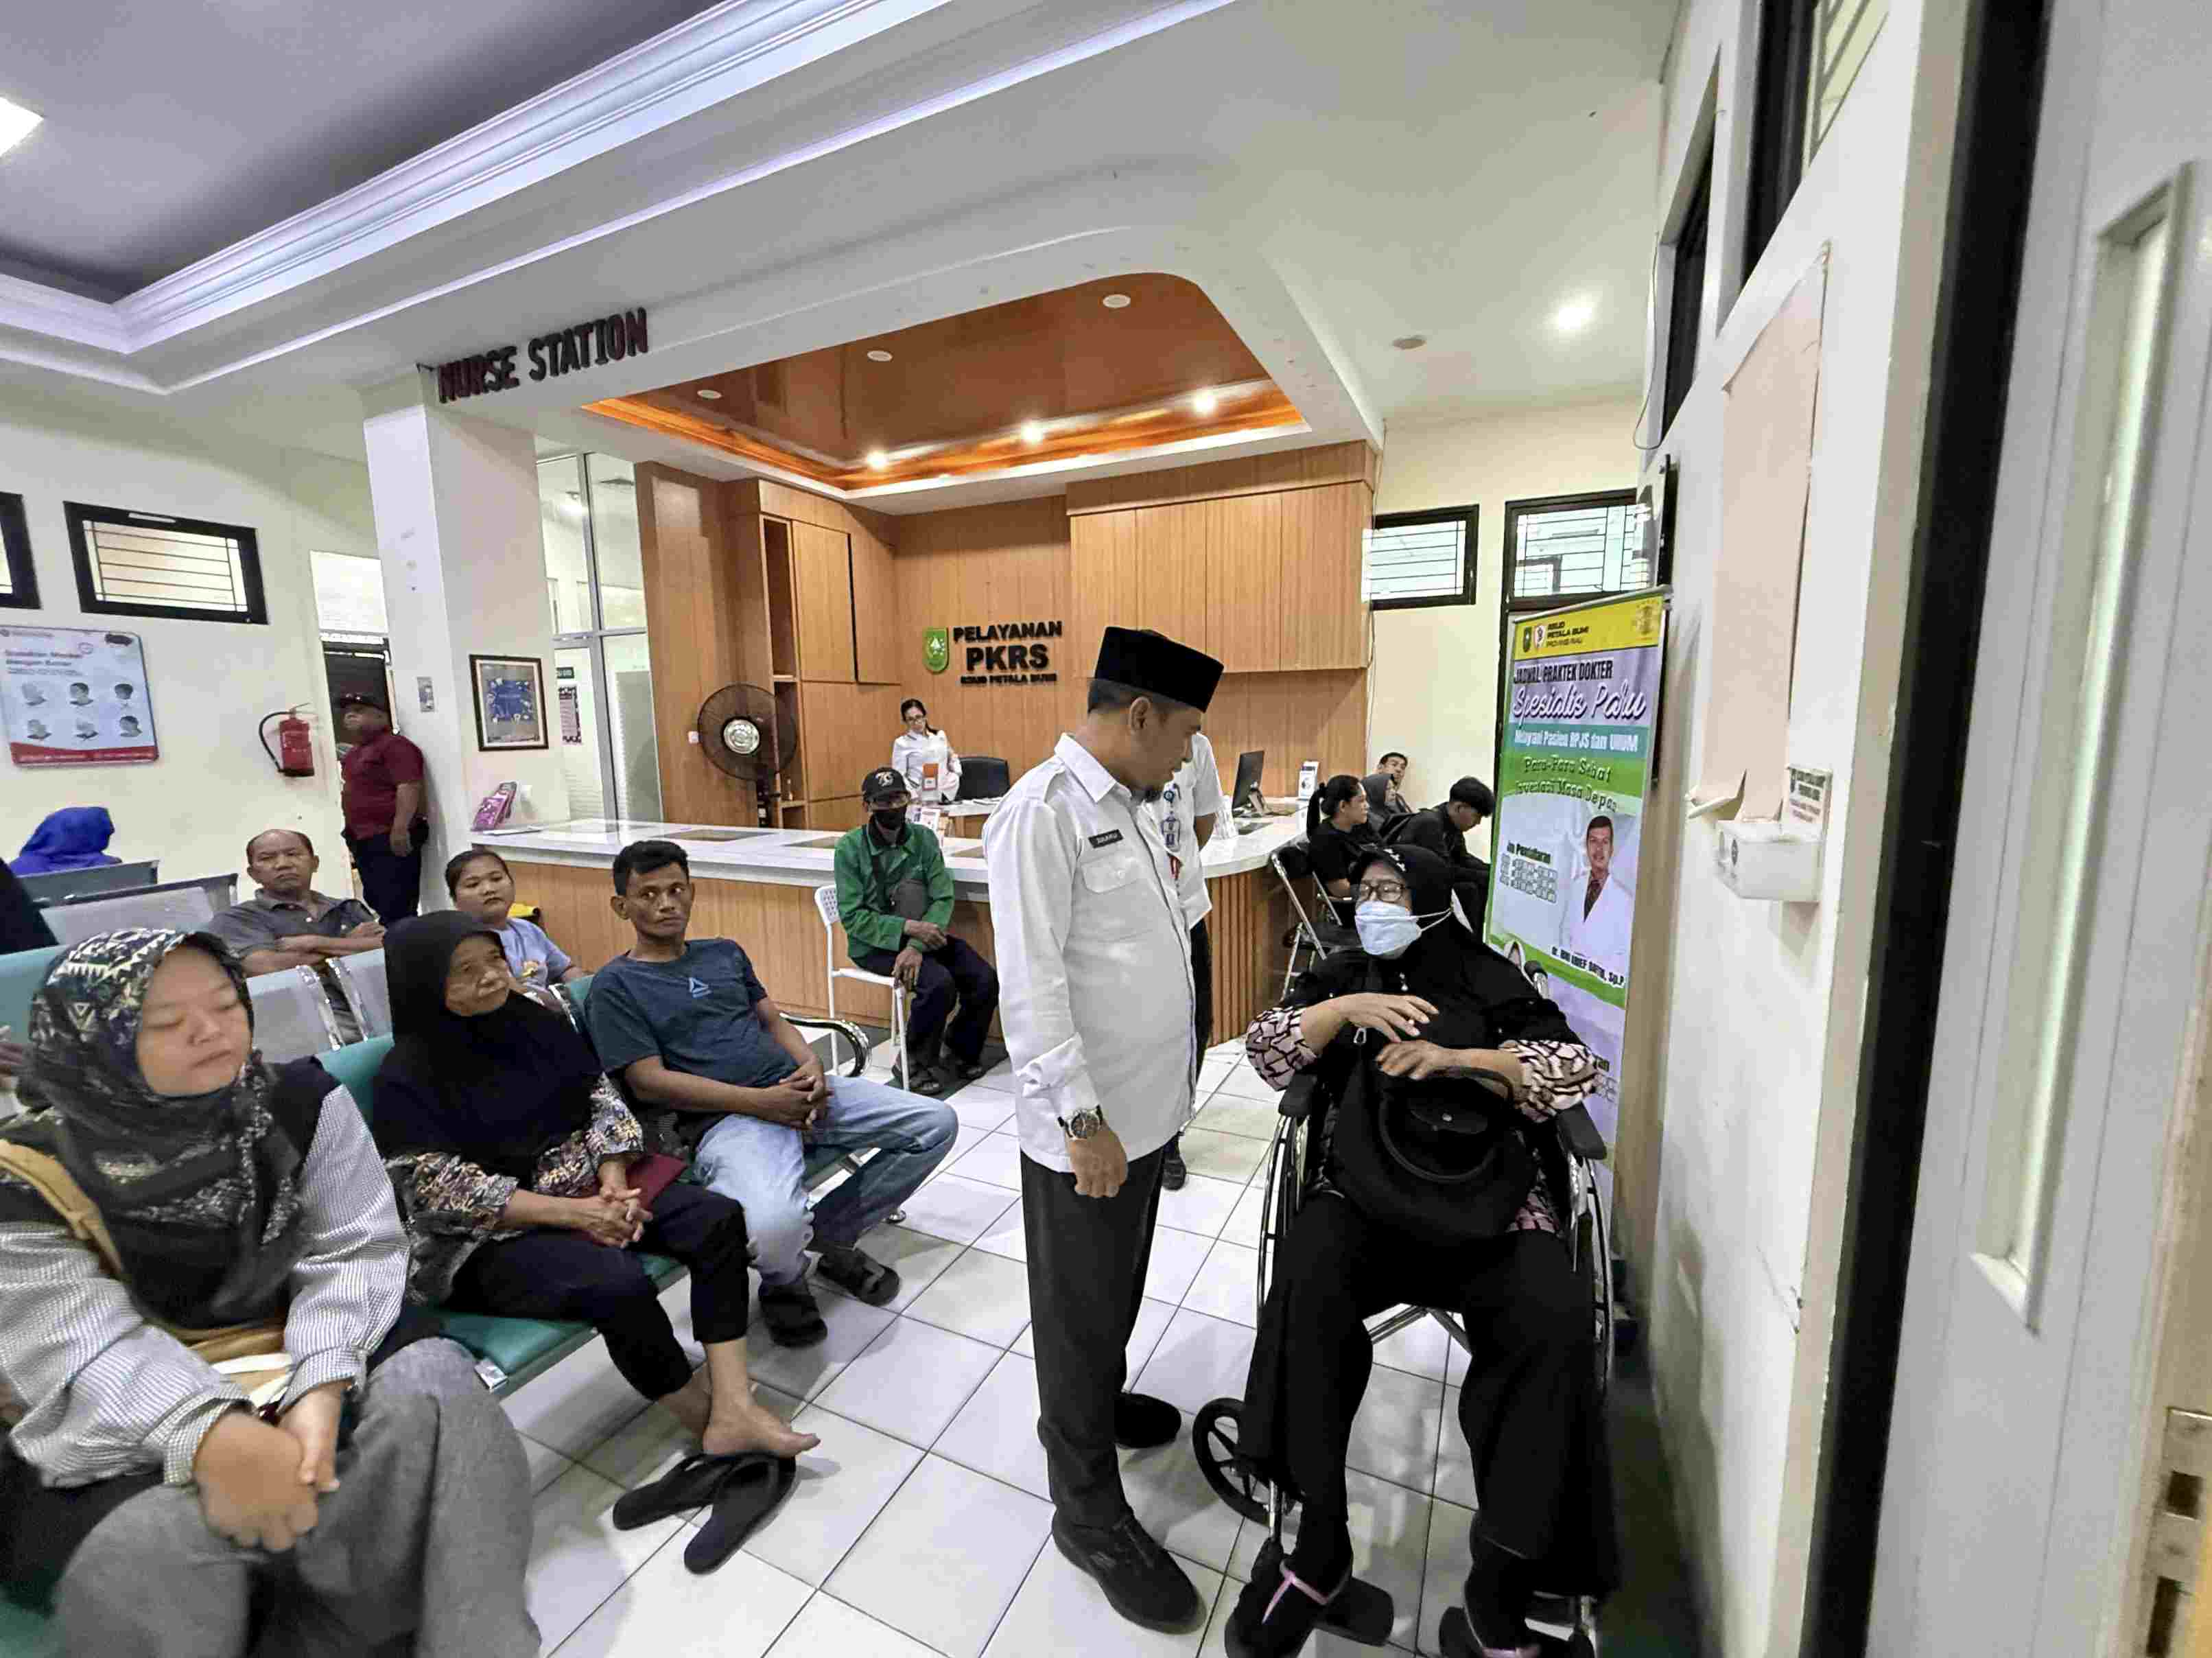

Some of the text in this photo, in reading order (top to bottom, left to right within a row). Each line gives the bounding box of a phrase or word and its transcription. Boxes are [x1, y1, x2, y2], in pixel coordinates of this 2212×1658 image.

[438, 307, 648, 404] NURSE STATION
[953, 621, 1063, 643] PELAYANAN
[966, 644, 1049, 671] PKRS
[989, 674, 1028, 684] PETALA
[1514, 659, 1614, 684] JADWAL PRAKTEK DOKTER
[1513, 684, 1588, 729] Spesialis
[1544, 730, 1569, 748] Pasien
[1590, 732, 1608, 750] dan
